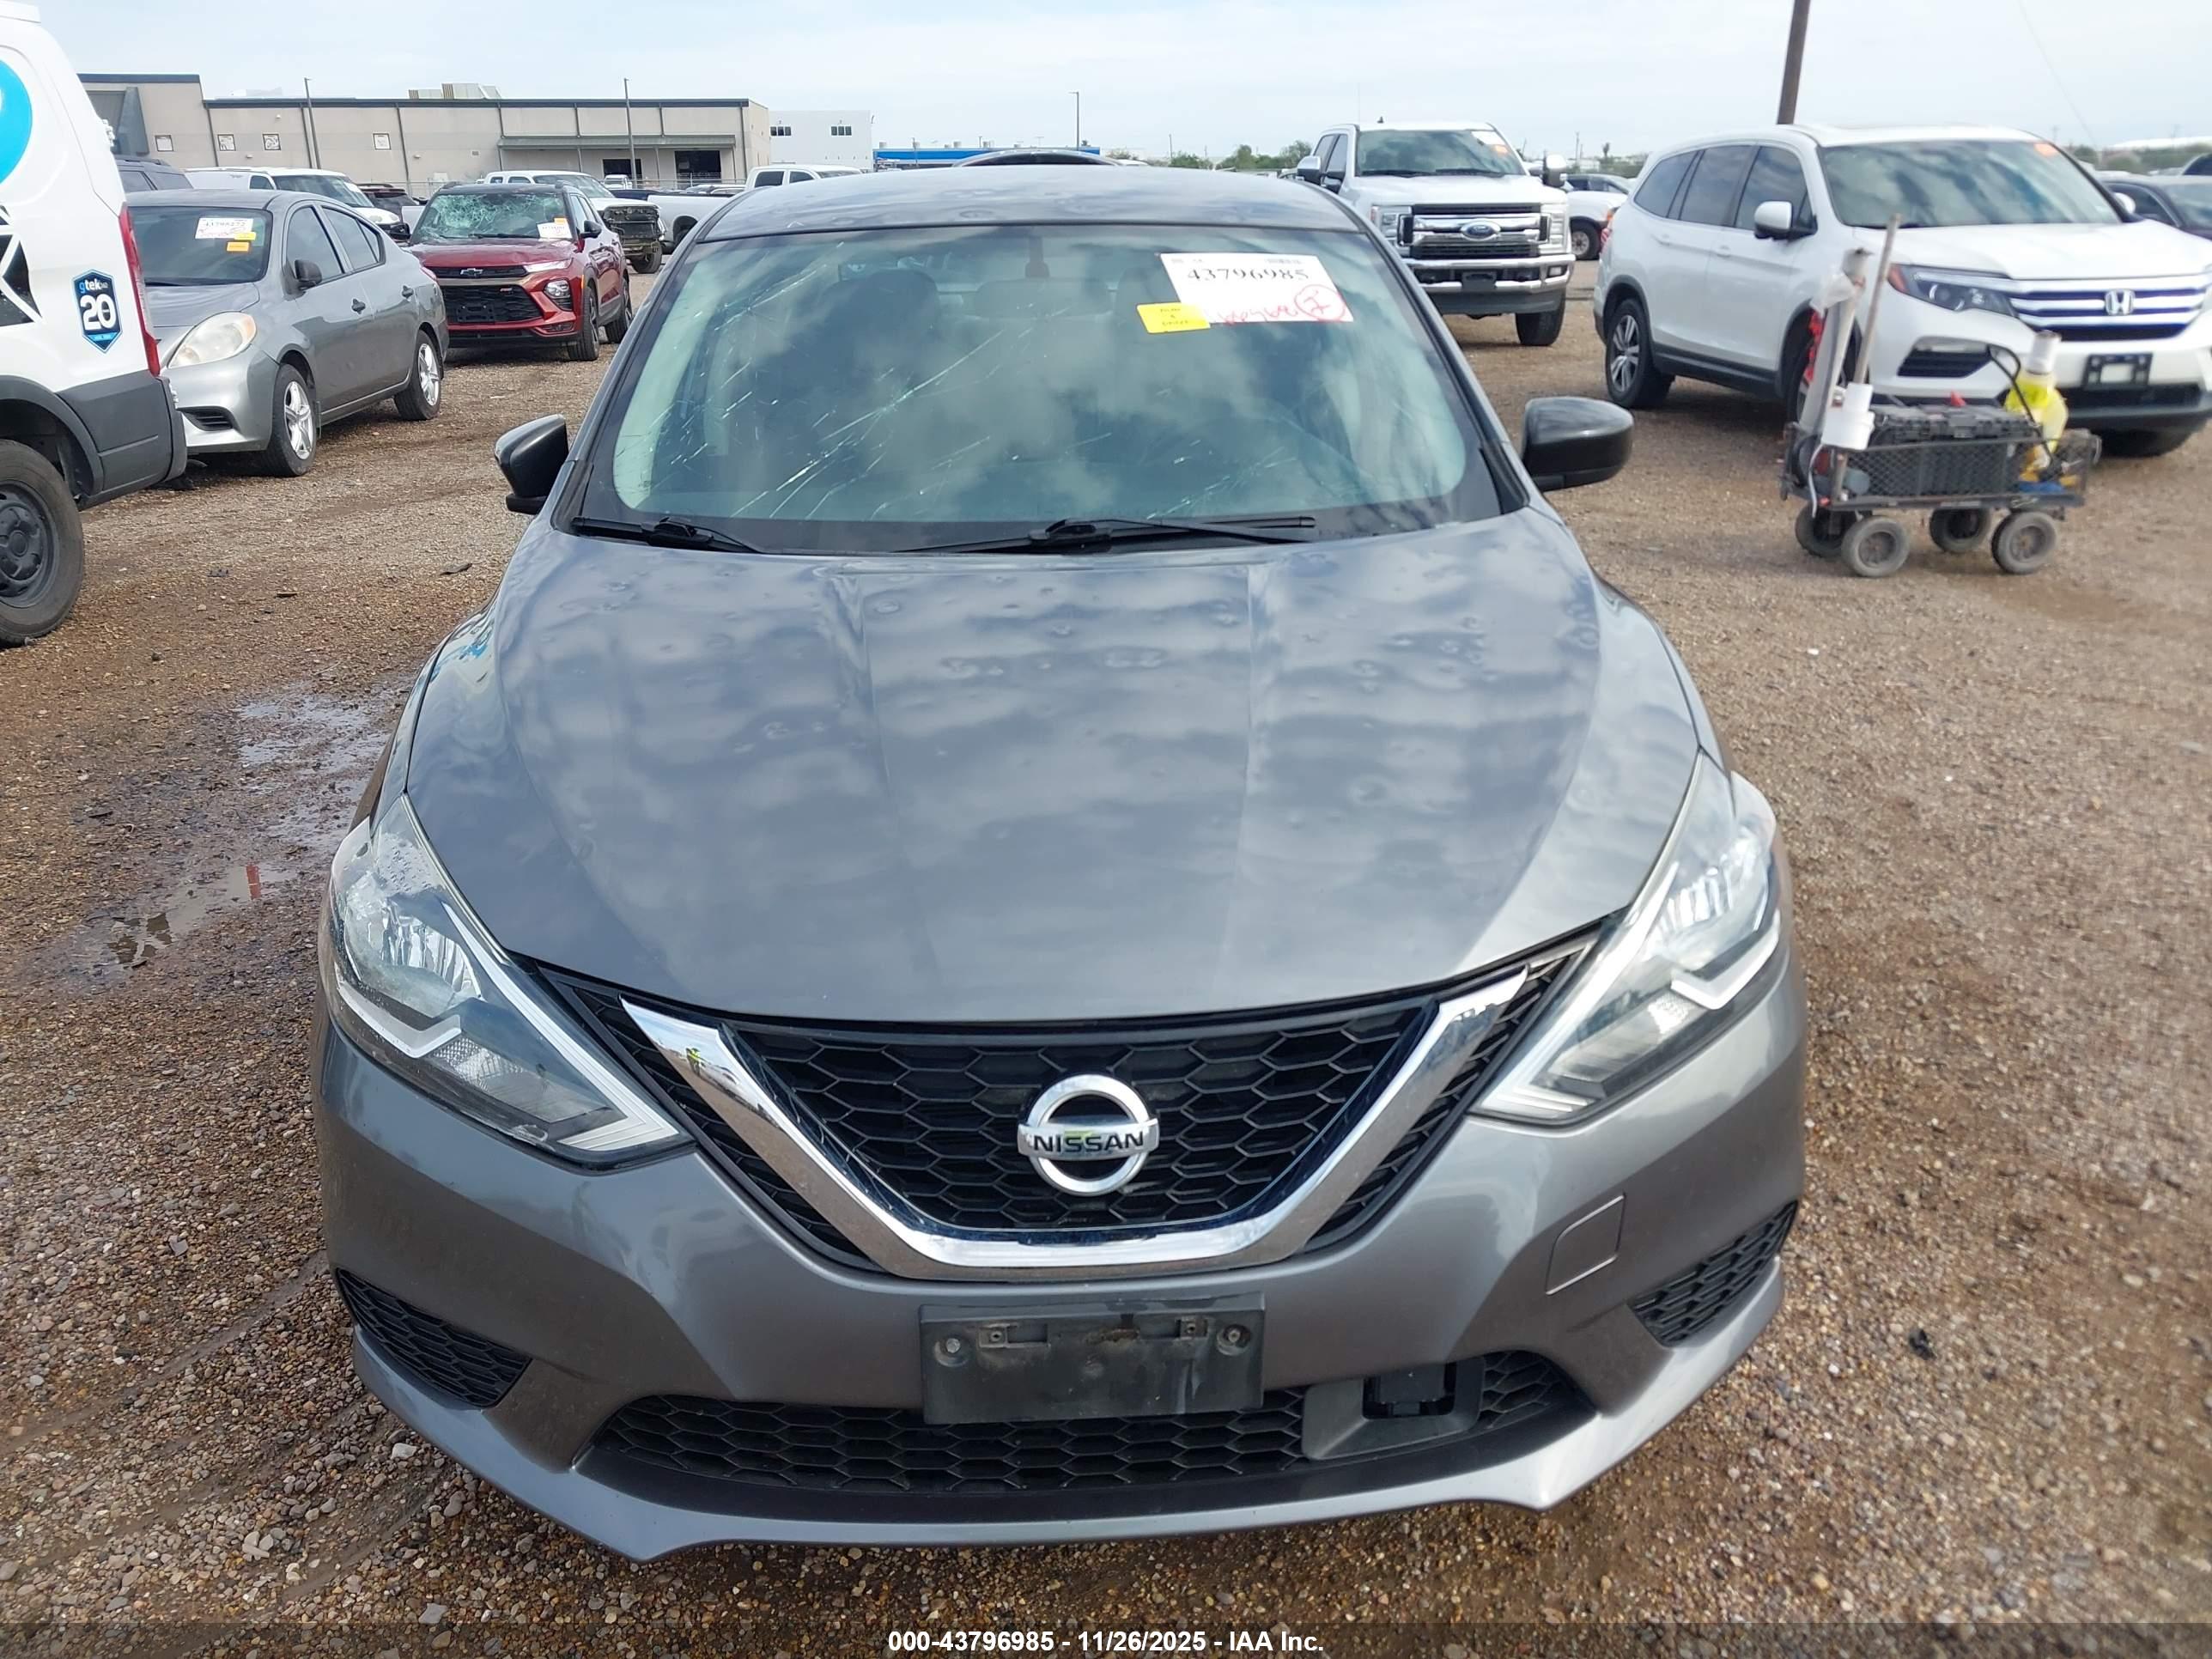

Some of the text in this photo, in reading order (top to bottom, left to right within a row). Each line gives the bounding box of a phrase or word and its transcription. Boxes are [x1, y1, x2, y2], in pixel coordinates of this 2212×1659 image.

[1187, 268, 1310, 281] 43796985
[80, 294, 117, 330] 20
[1033, 1131, 1144, 1152] NISSAN
